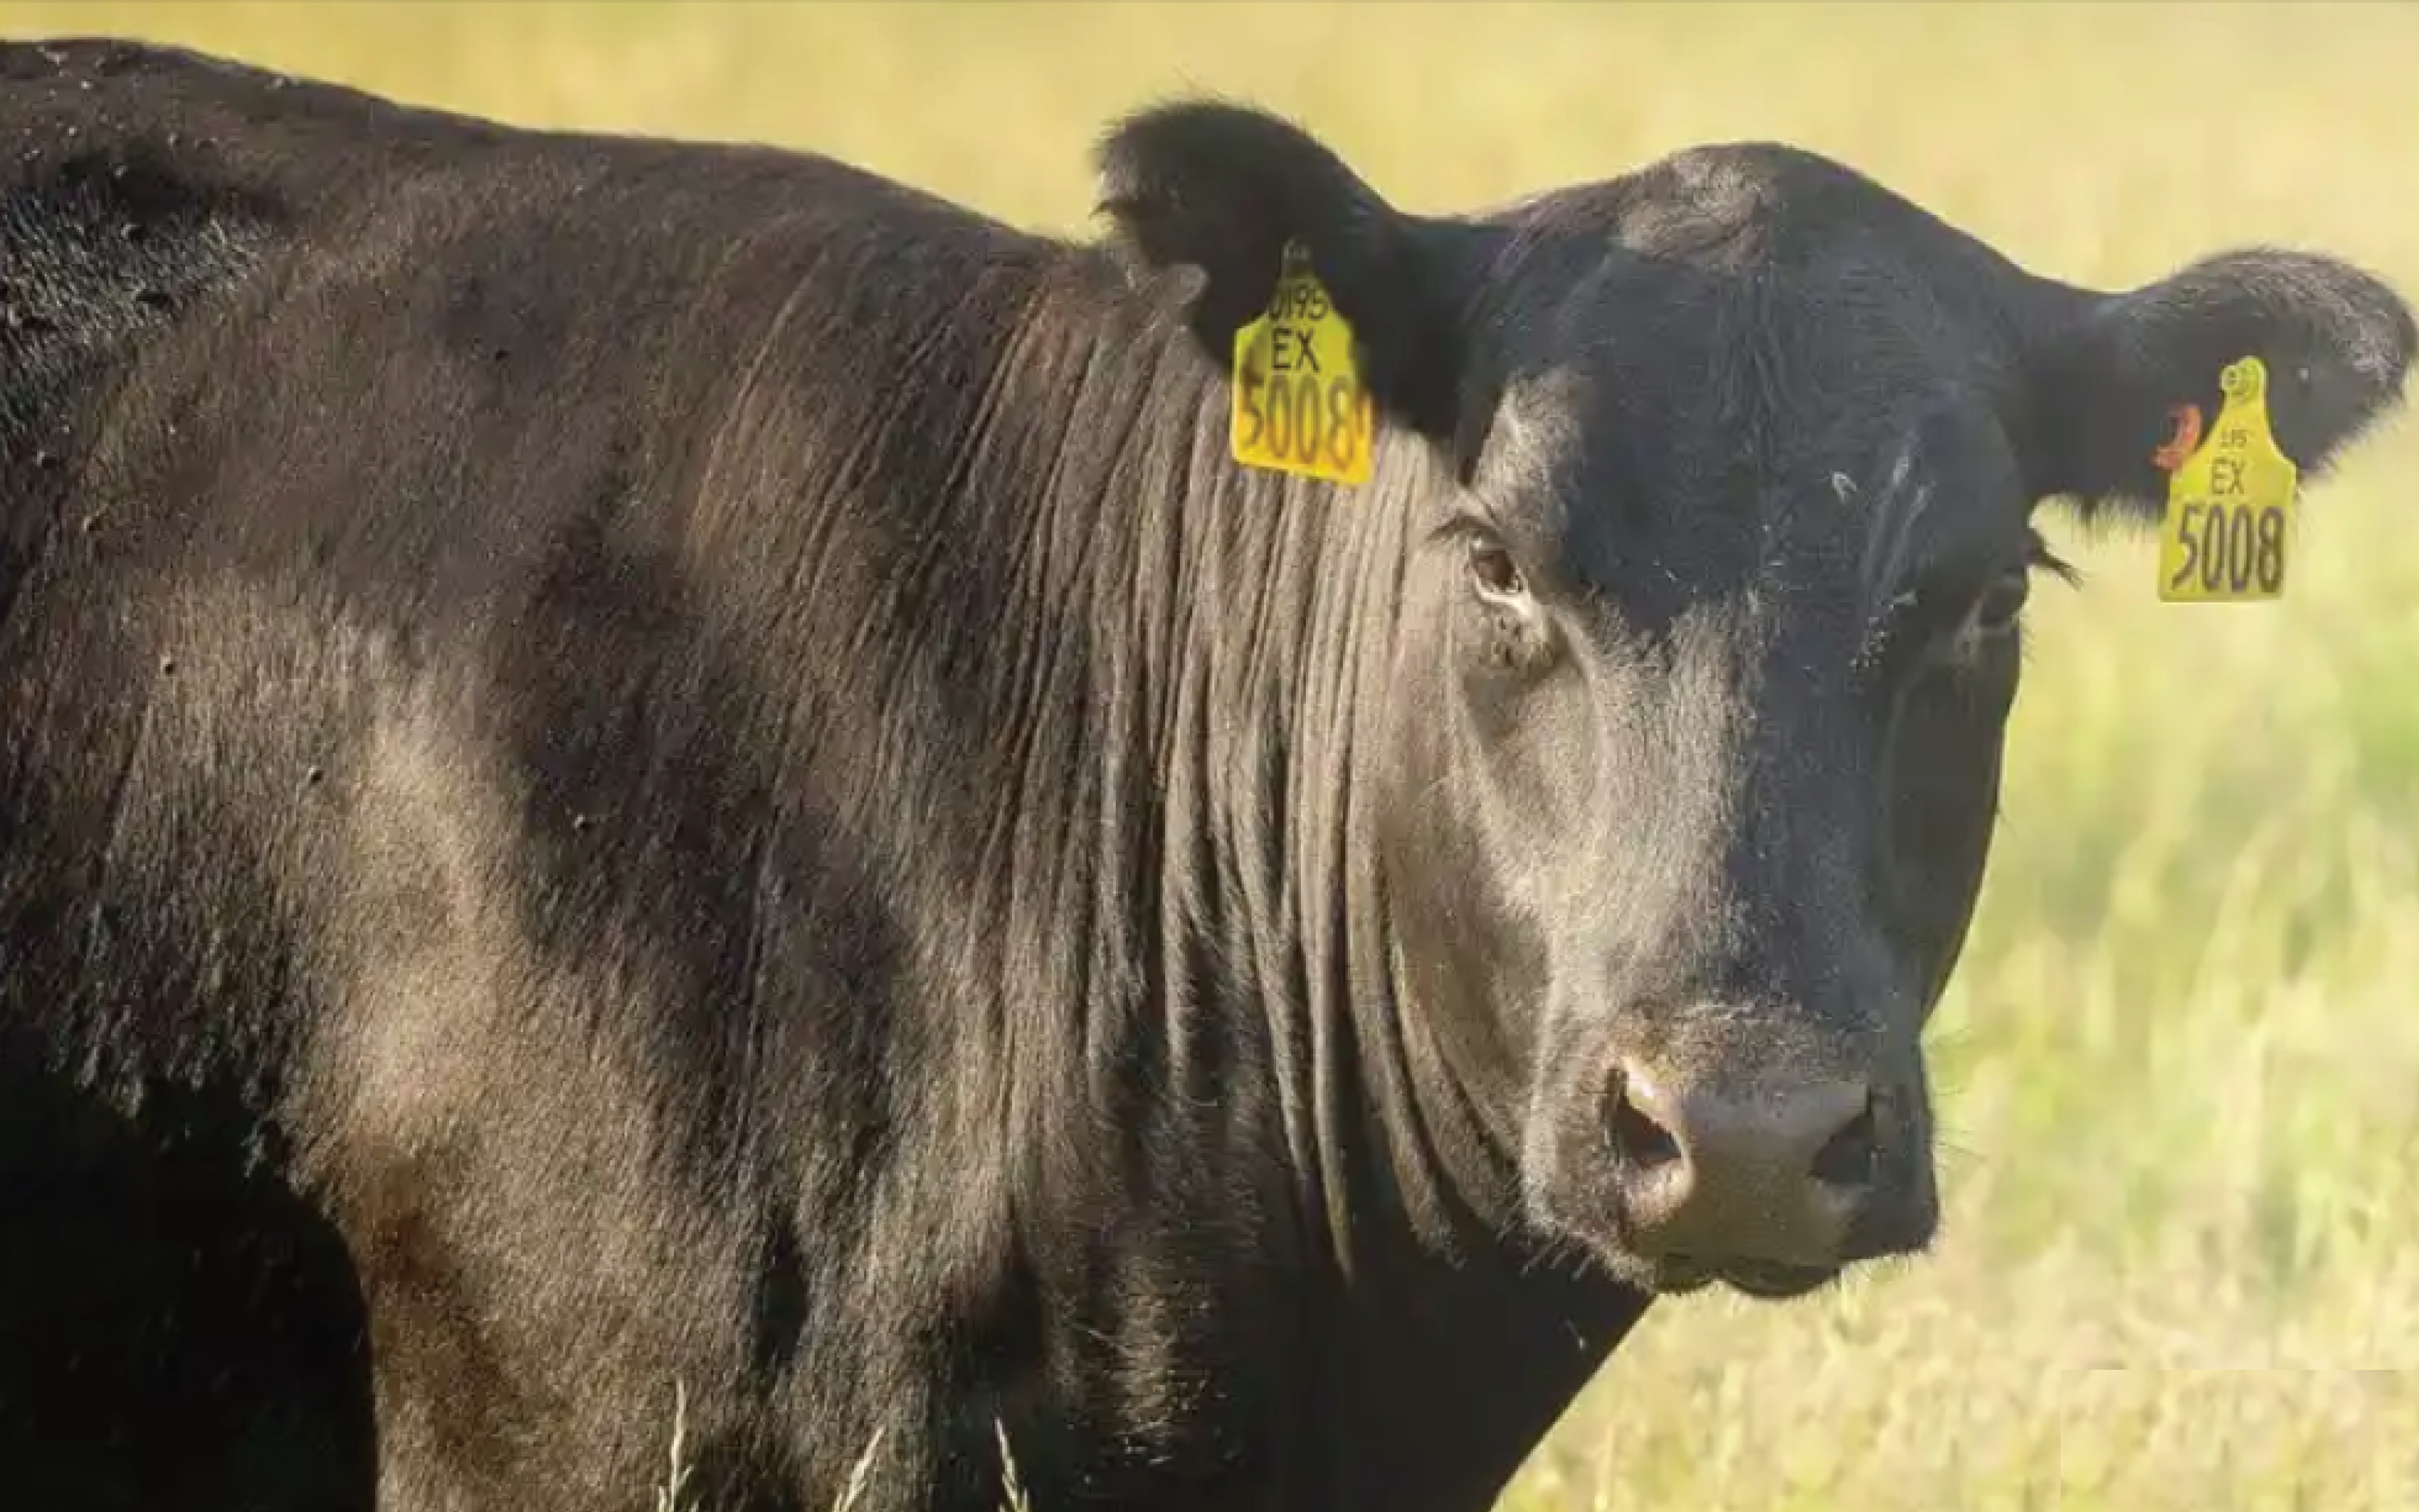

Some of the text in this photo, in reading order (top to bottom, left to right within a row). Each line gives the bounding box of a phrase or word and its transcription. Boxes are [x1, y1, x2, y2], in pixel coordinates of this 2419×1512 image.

[1272, 326, 1321, 373] EX
[1239, 371, 1355, 472] 5008
[2211, 456, 2246, 496] EX
[2171, 504, 2283, 593] 5008
